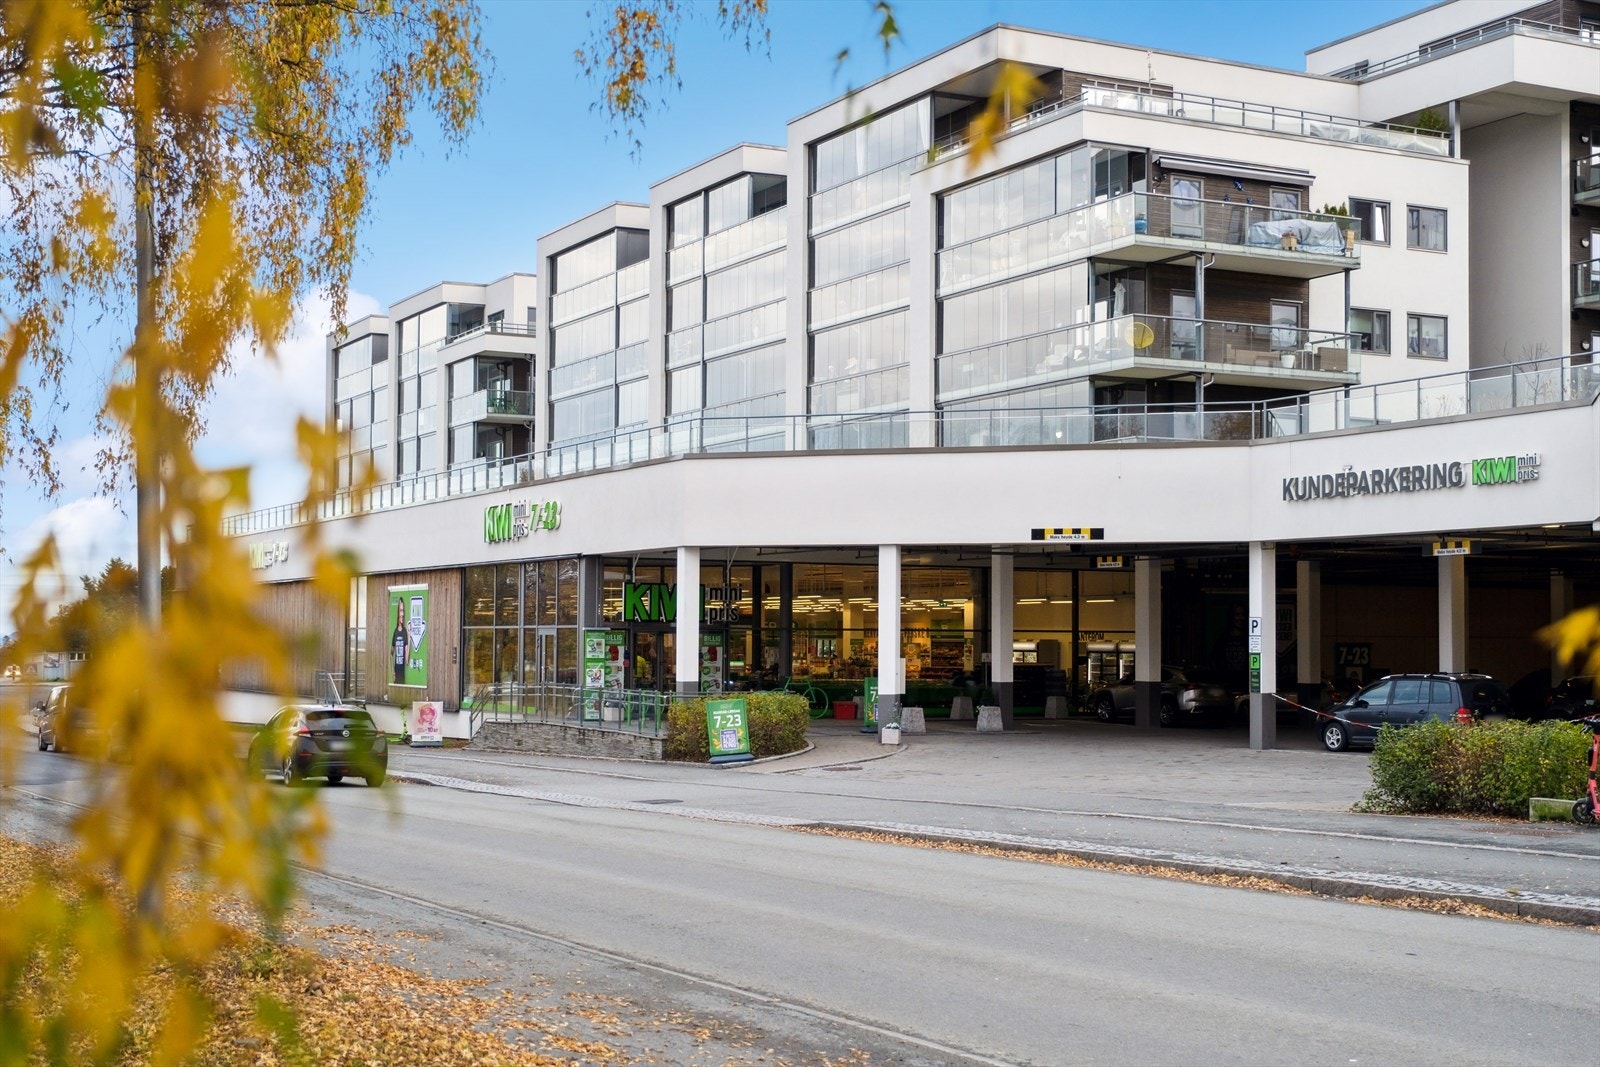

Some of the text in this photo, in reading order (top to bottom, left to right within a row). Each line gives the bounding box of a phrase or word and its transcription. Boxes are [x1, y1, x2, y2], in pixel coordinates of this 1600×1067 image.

[1517, 453, 1537, 466] mini
[1283, 456, 1517, 501] KUNDEPARKERING KIWI
[1517, 467, 1537, 484] pris
[484, 500, 528, 544] KIWI mini
[530, 501, 561, 532] 7-23
[708, 583, 743, 602] mini
[708, 601, 740, 624] pris
[1251, 620, 1259, 634] P
[1252, 656, 1258, 667] P
[1339, 647, 1369, 665] 7-23
[713, 714, 742, 728] 7-23
